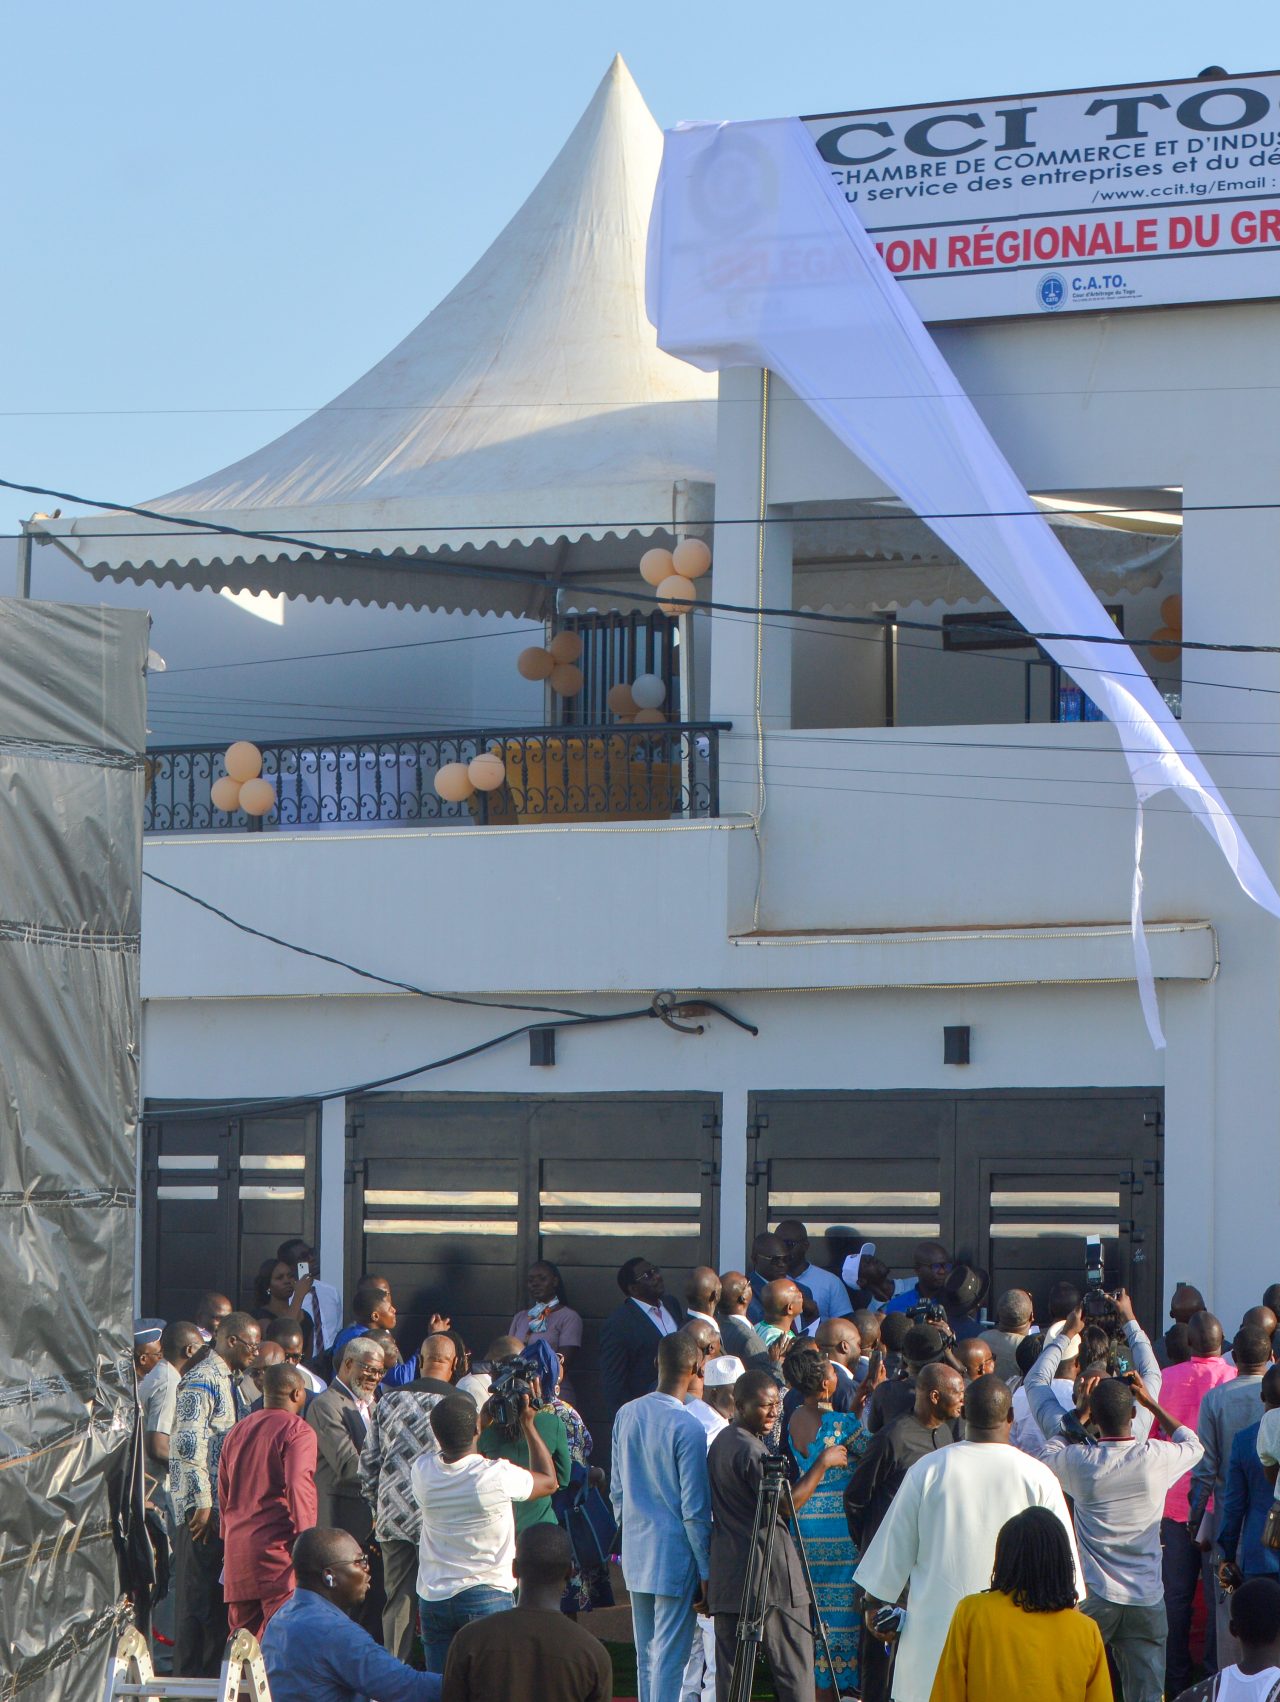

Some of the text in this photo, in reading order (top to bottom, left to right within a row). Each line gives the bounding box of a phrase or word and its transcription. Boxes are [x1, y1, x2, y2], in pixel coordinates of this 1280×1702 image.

[815, 106, 1038, 166] CCI
[956, 158, 986, 175] DE
[994, 142, 1146, 171] COMMERCE
[1155, 140, 1179, 156] ET
[845, 191, 859, 203] u
[867, 181, 958, 201] service
[967, 175, 1013, 192] des
[1021, 162, 1163, 186] entreprises
[1172, 156, 1198, 174] et
[1206, 154, 1239, 171] du
[948, 218, 1158, 268] RÉGIONALE
[1169, 213, 1220, 250] DU
